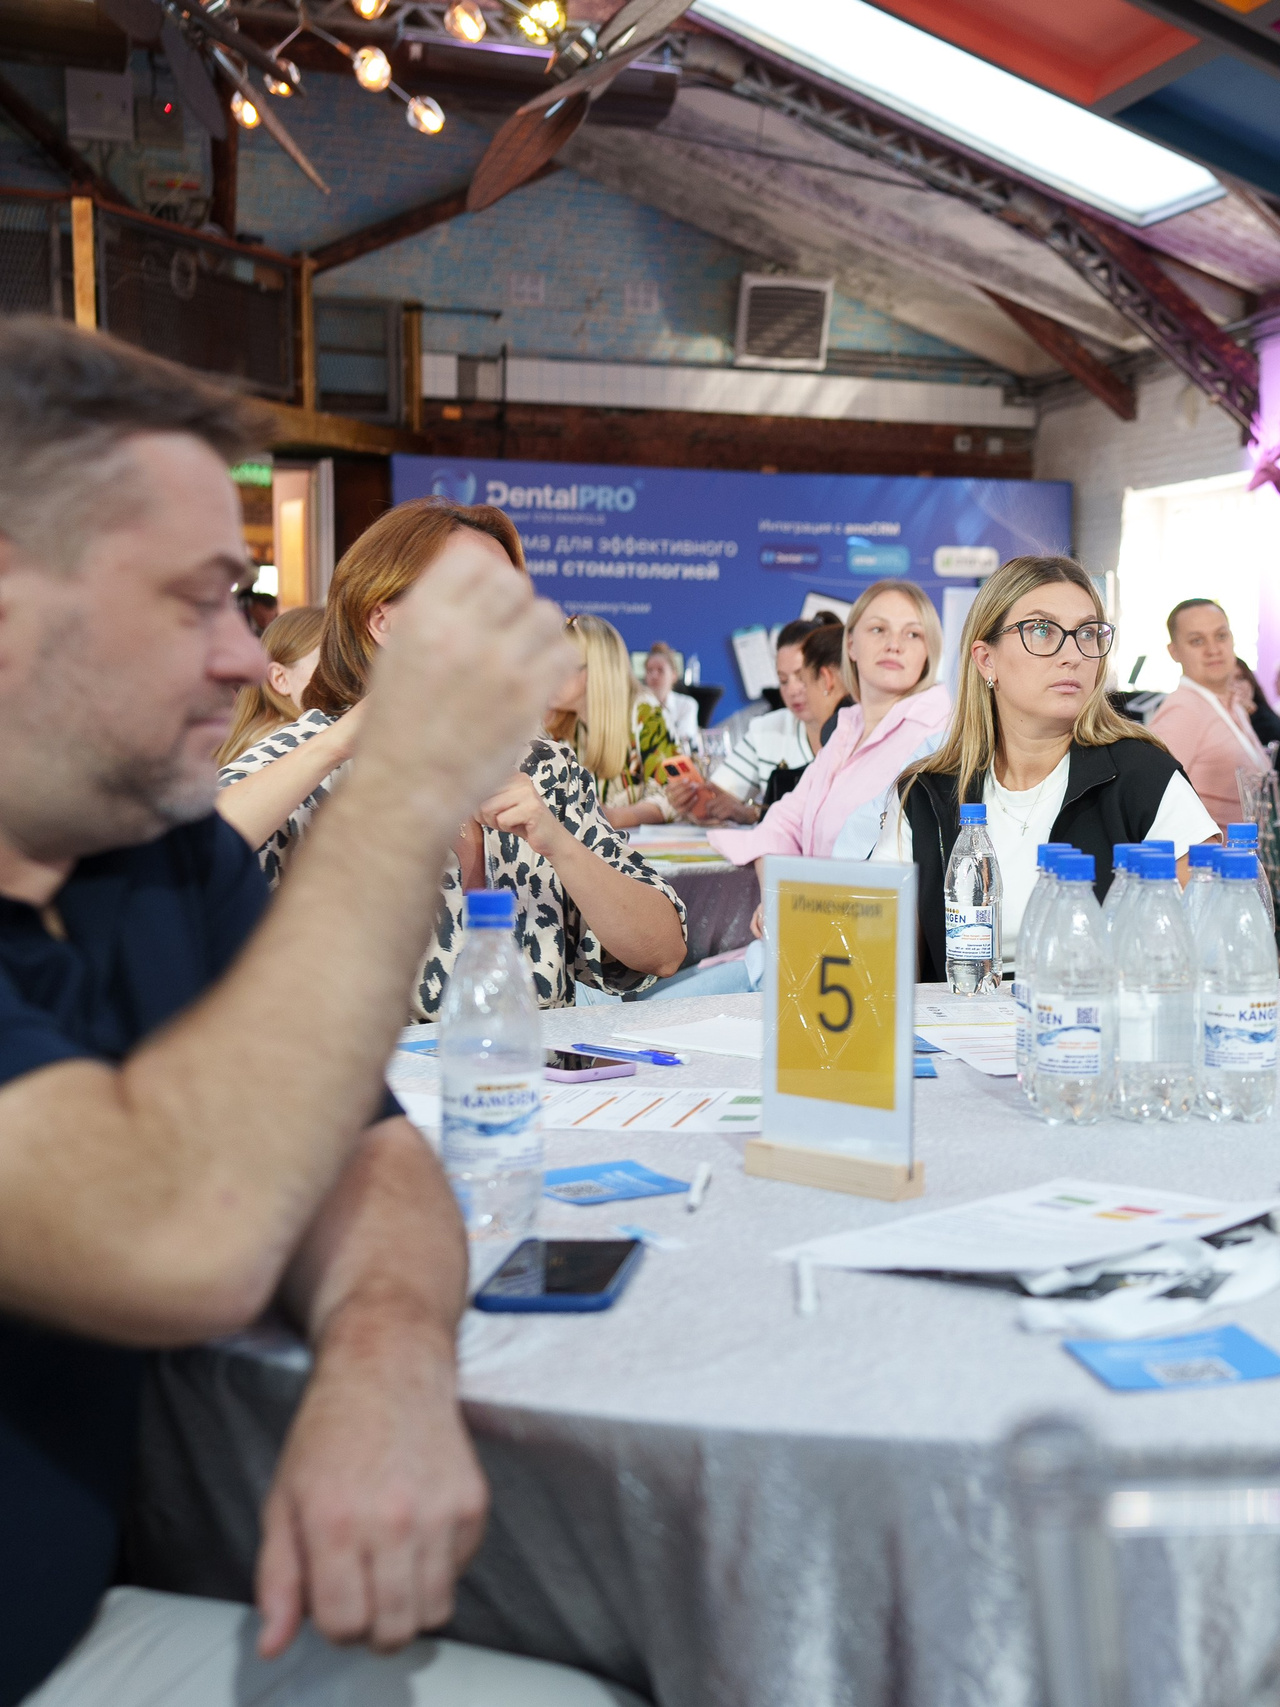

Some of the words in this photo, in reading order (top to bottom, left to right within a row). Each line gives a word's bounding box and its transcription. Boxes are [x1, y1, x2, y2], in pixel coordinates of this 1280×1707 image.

[486, 480, 637, 512] DentalPRO
[555, 537, 593, 555] для
[598, 536, 738, 559] эффективного
[562, 559, 720, 581] стоматологией
[791, 894, 882, 918] Инженерия
[816, 955, 855, 1033] 5
[1037, 1012, 1062, 1025] GEN
[1239, 1009, 1278, 1021] KANG
